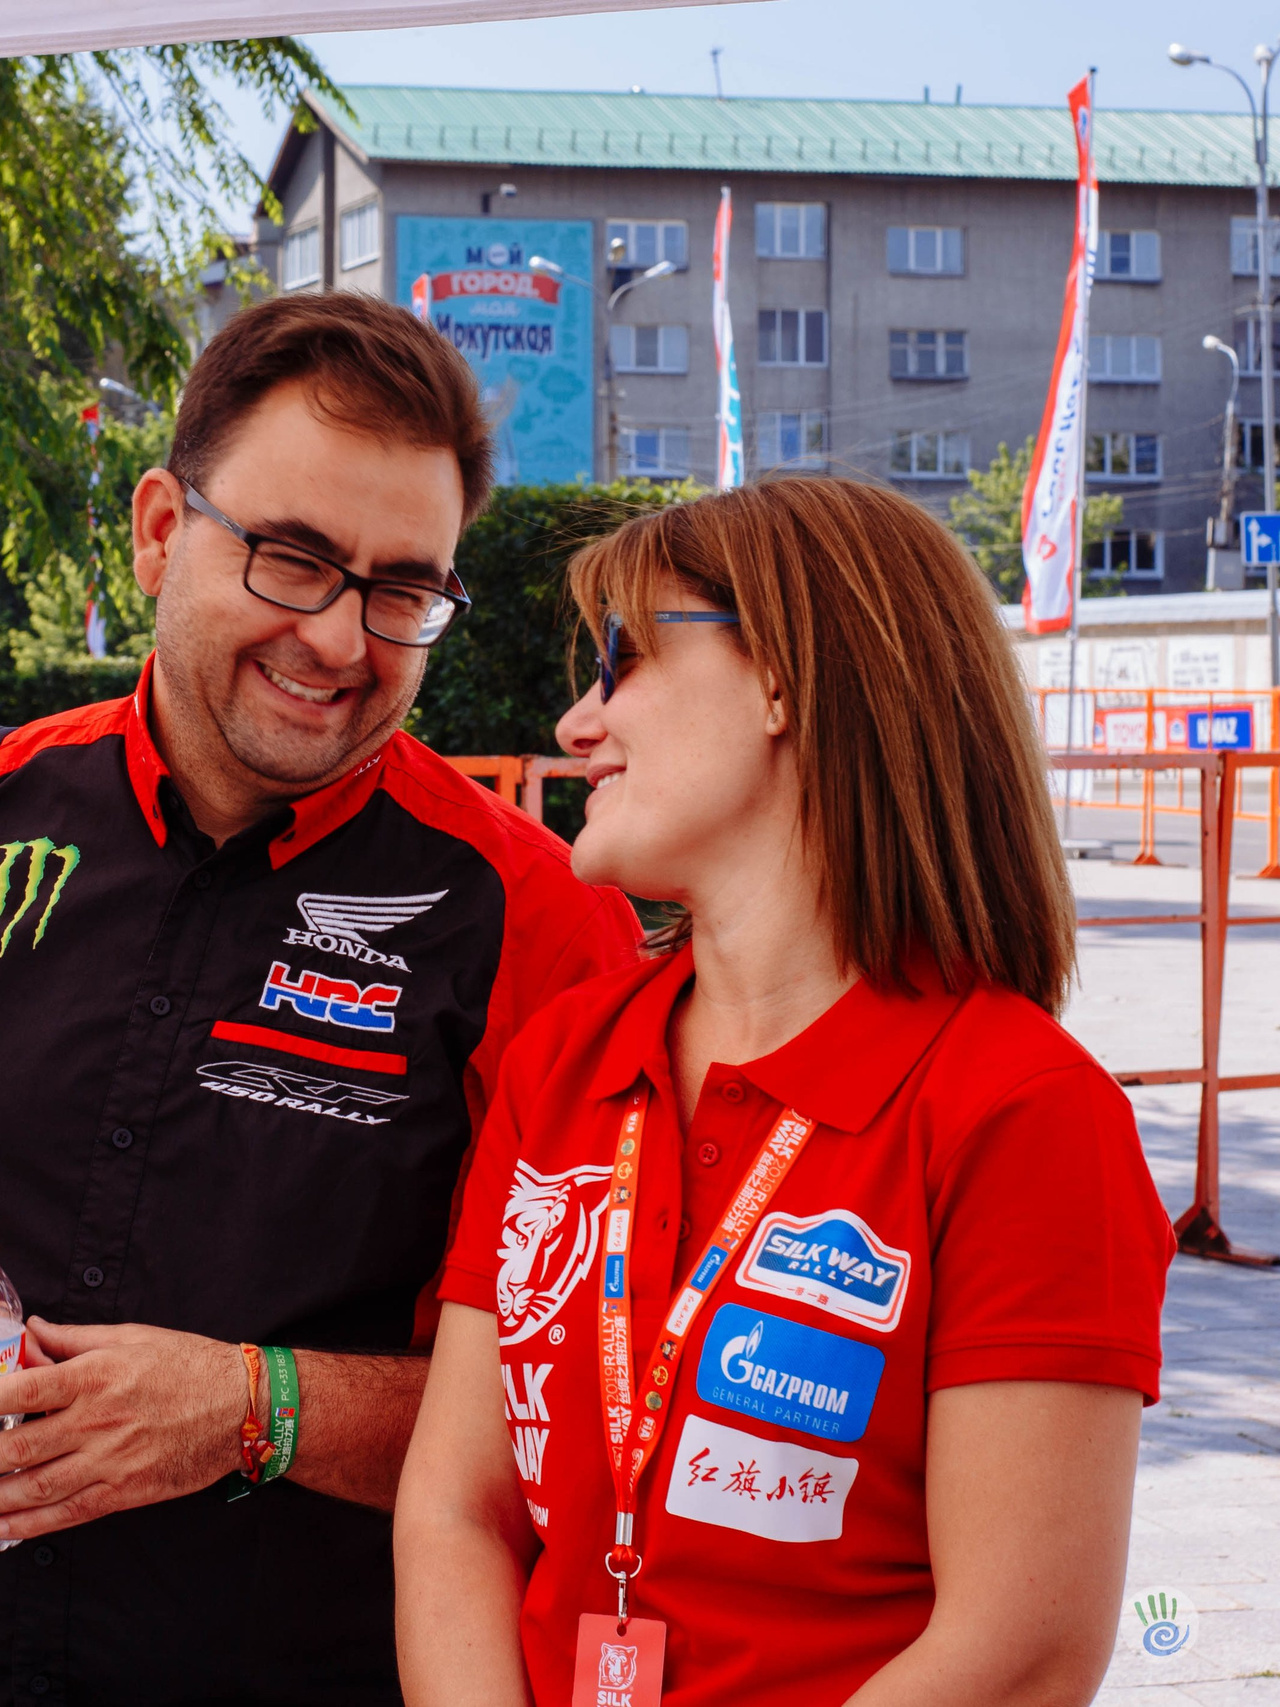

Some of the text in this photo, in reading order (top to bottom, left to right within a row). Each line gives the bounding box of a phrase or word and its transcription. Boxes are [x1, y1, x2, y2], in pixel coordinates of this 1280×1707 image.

[282, 928, 412, 973] HONDA
[259, 961, 403, 1033] HRC
[274, 1096, 391, 1125] RALLY
[768, 1119, 796, 1155] WAY
[780, 1123, 807, 1160] SILK
[764, 1234, 897, 1287] SILK WAY
[788, 1260, 855, 1286] RALLY
[279, 1369, 288, 1385] +33
[281, 1387, 290, 1401] PC
[501, 1363, 554, 1422] LK
[750, 1365, 850, 1415] GAZPROM
[607, 1405, 624, 1444] SILK
[639, 1416, 654, 1440] FIA
[713, 1386, 841, 1434] GENERAL PARTNER
[687, 1447, 836, 1504] 红旗小镇
[597, 1690, 632, 1707] SILK
